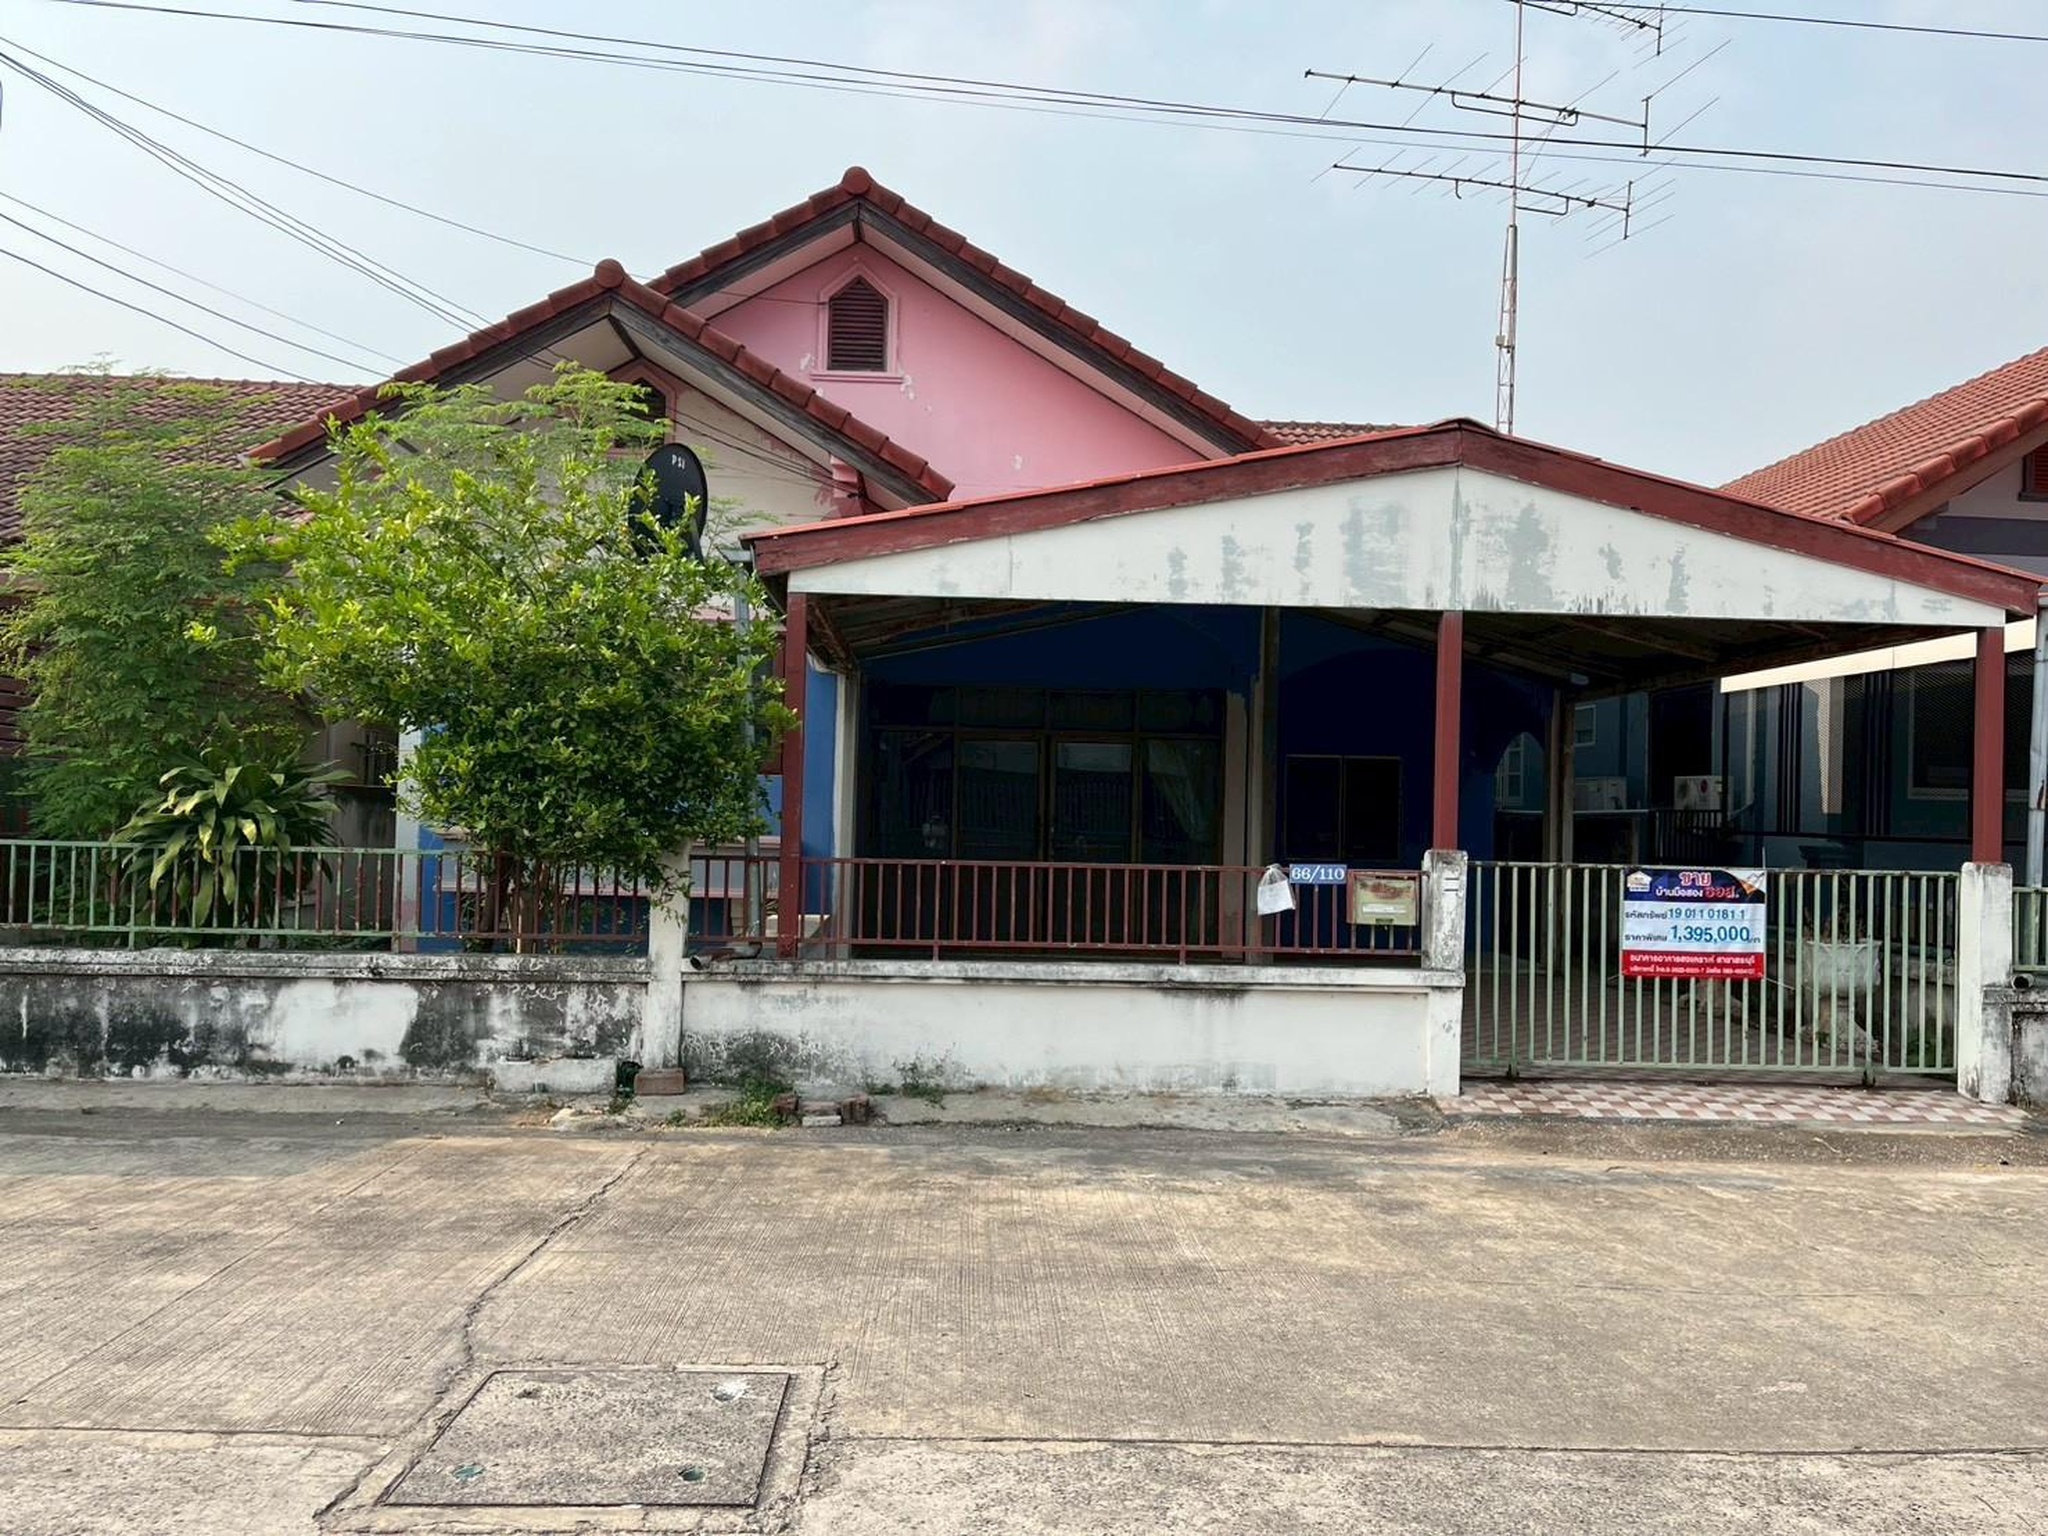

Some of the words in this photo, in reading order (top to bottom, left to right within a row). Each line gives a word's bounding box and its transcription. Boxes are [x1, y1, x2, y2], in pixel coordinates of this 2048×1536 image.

[1291, 865, 1345, 883] 66/110
[1679, 871, 1712, 886] ขาย
[1655, 886, 1703, 898] บ้านมือสอง
[1671, 925, 1750, 943] 1,395,000
